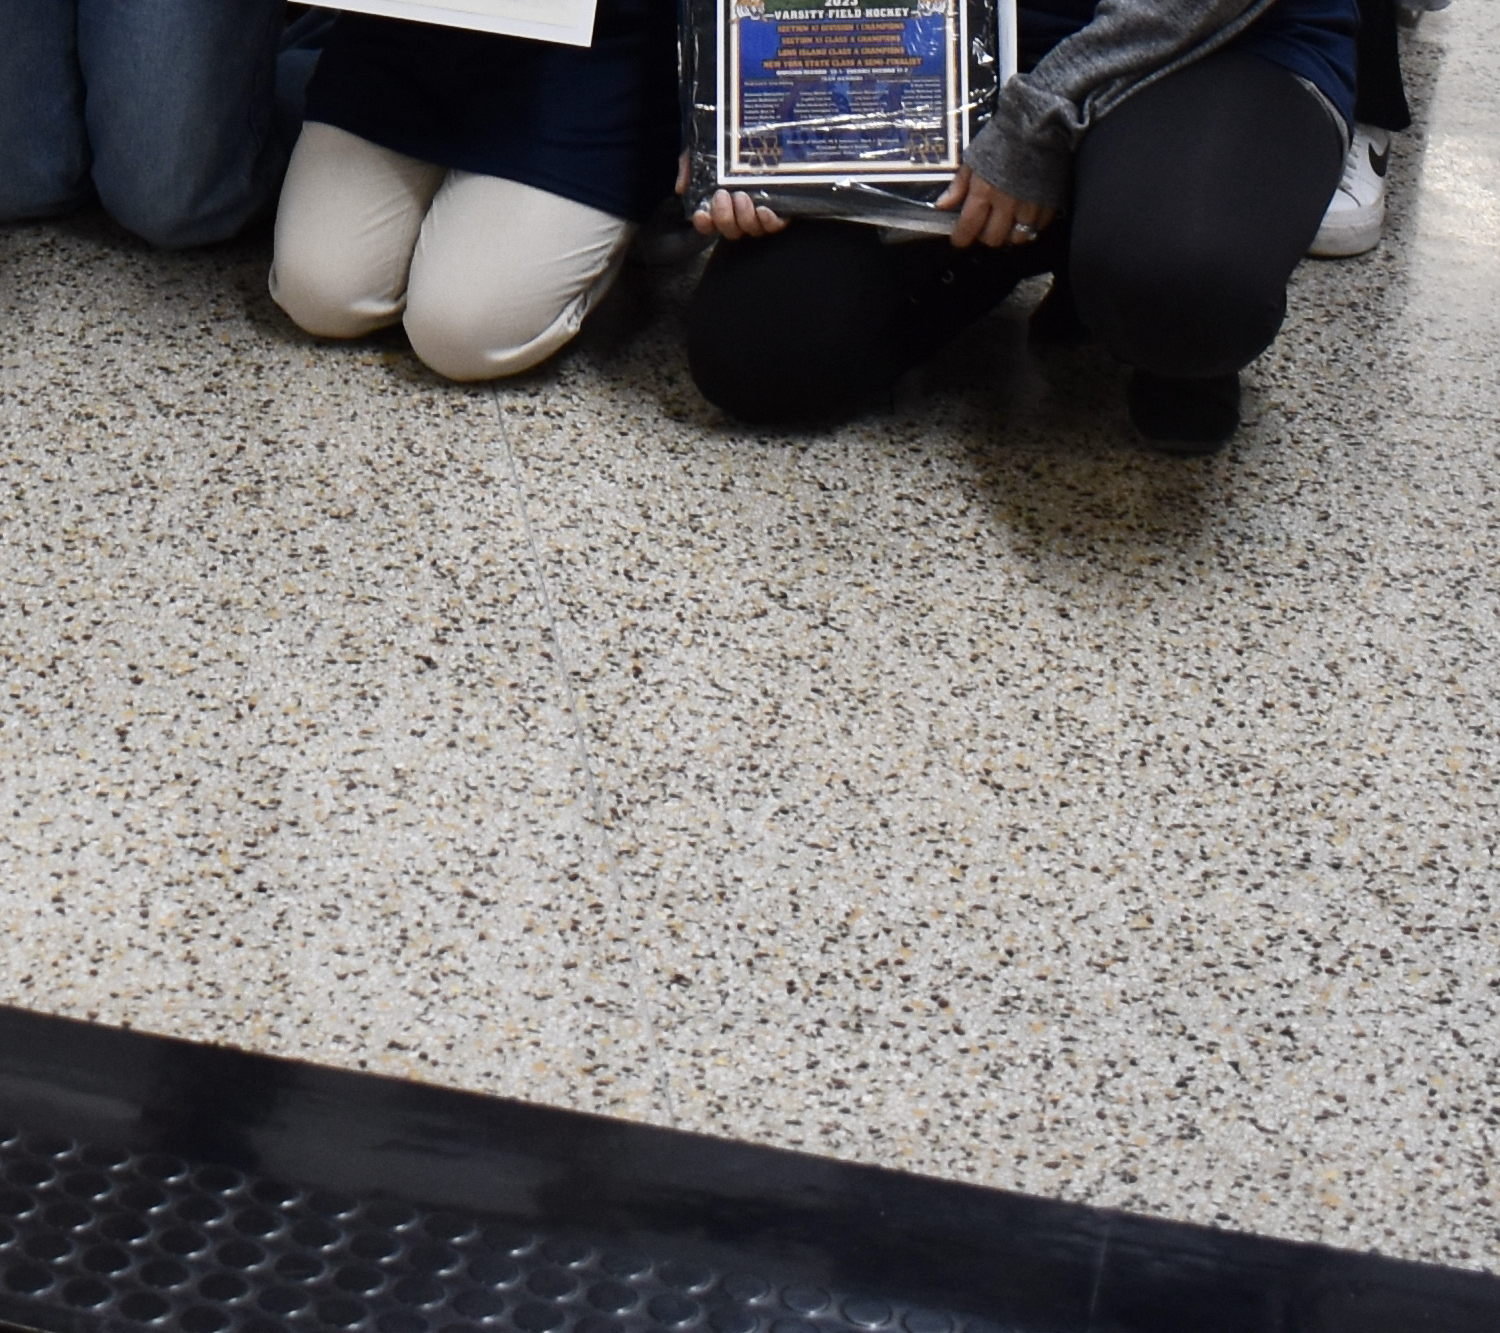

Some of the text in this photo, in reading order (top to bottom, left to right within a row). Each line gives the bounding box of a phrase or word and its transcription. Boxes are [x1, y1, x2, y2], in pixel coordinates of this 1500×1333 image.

[774, 8, 909, 20] VARSITY FIELD HOCKEY
